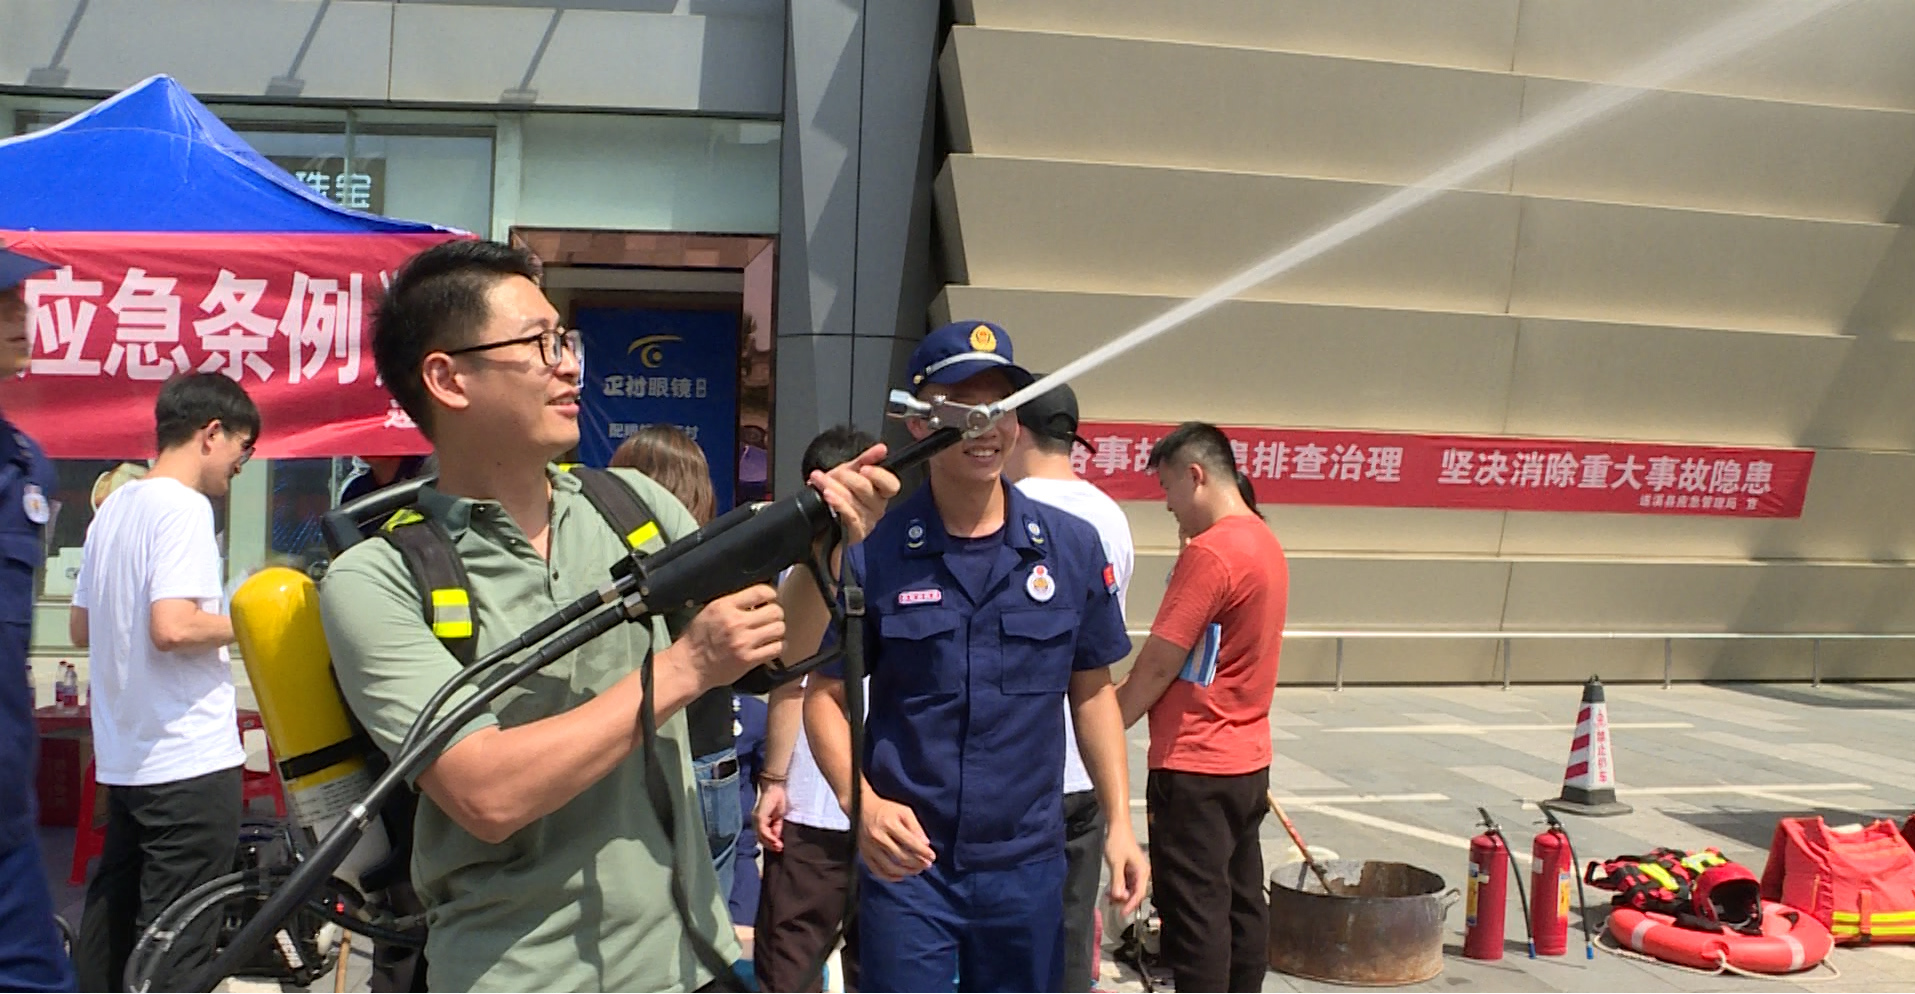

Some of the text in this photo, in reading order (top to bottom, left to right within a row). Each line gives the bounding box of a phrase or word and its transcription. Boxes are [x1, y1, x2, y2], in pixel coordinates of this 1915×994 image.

[17, 265, 399, 386] 应急条例
[1438, 448, 1774, 495] 坚决消除重大事故隐患
